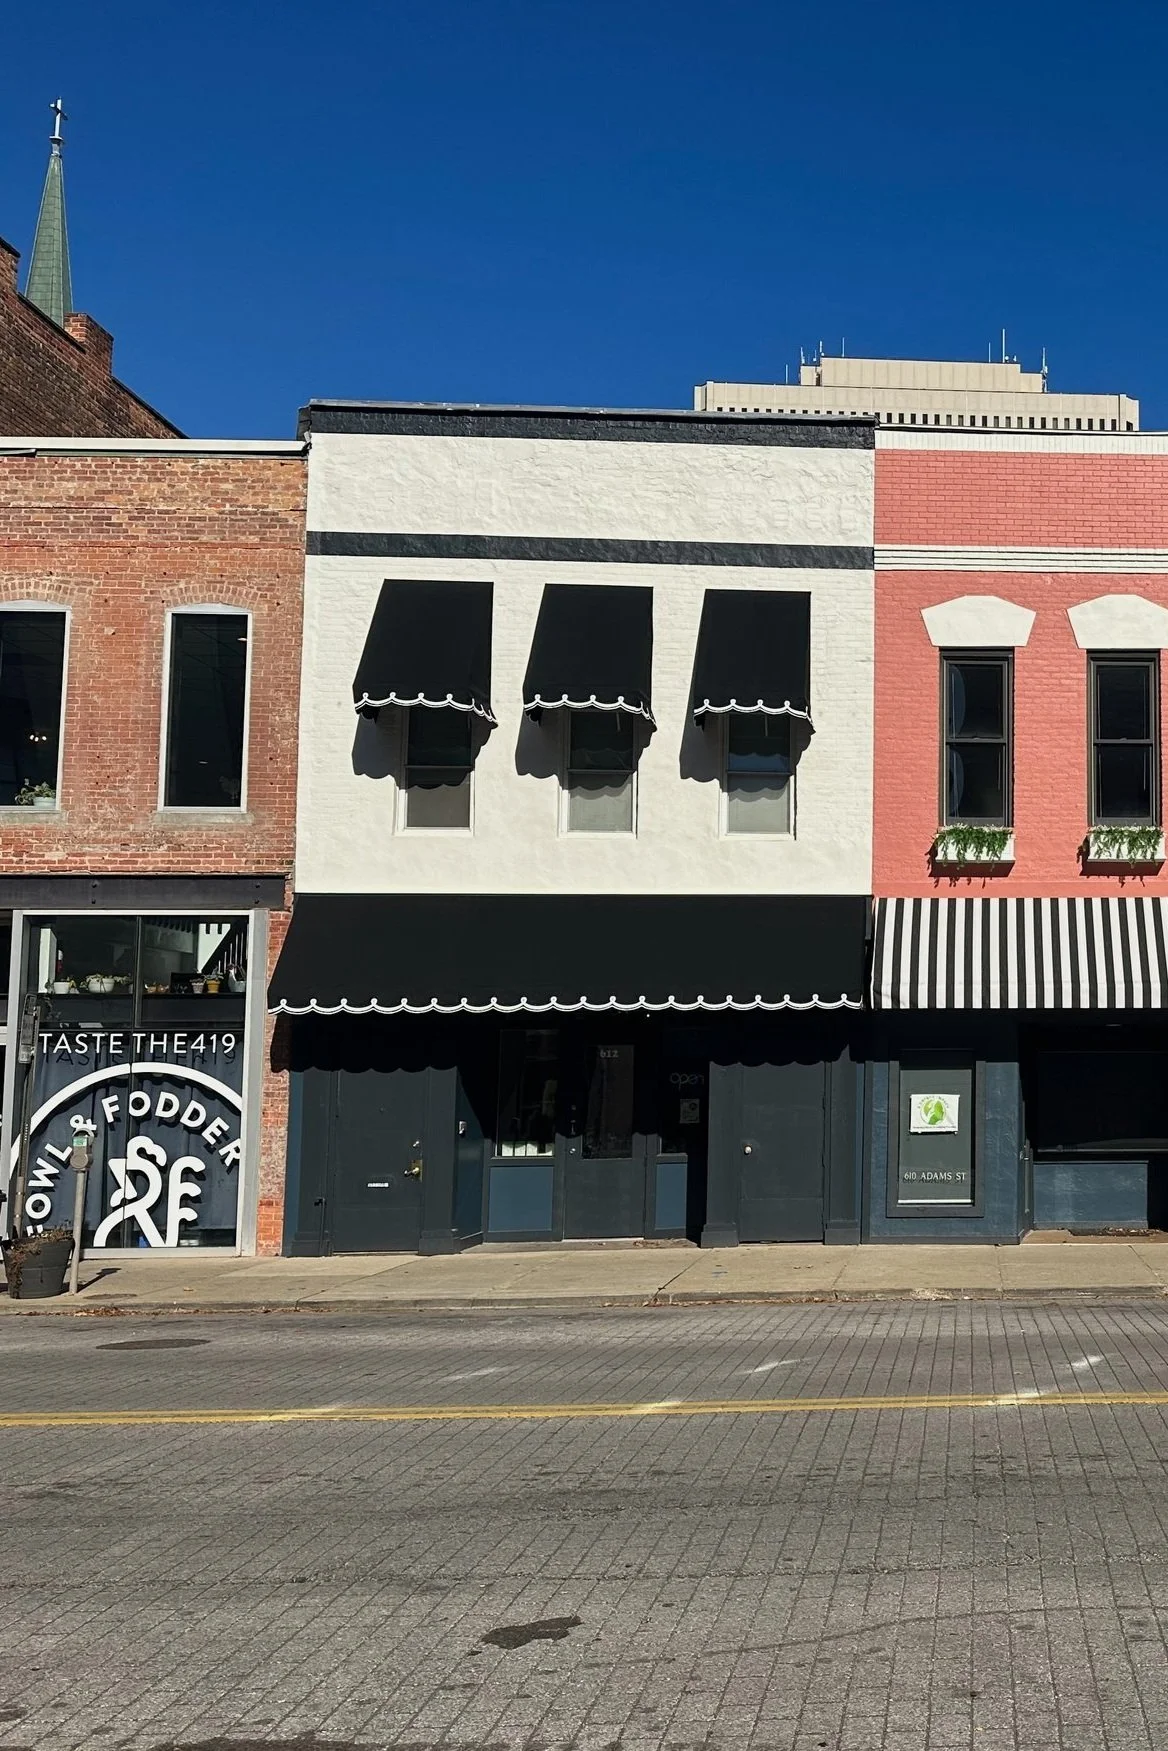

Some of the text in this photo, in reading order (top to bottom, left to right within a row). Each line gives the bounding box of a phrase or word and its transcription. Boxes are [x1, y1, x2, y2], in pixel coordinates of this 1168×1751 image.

[39, 1033, 124, 1054] TASTE
[600, 1049, 619, 1058] 612
[101, 1090, 240, 1167] FODDER
[904, 1171, 966, 1180] 610 ADAMS ST
